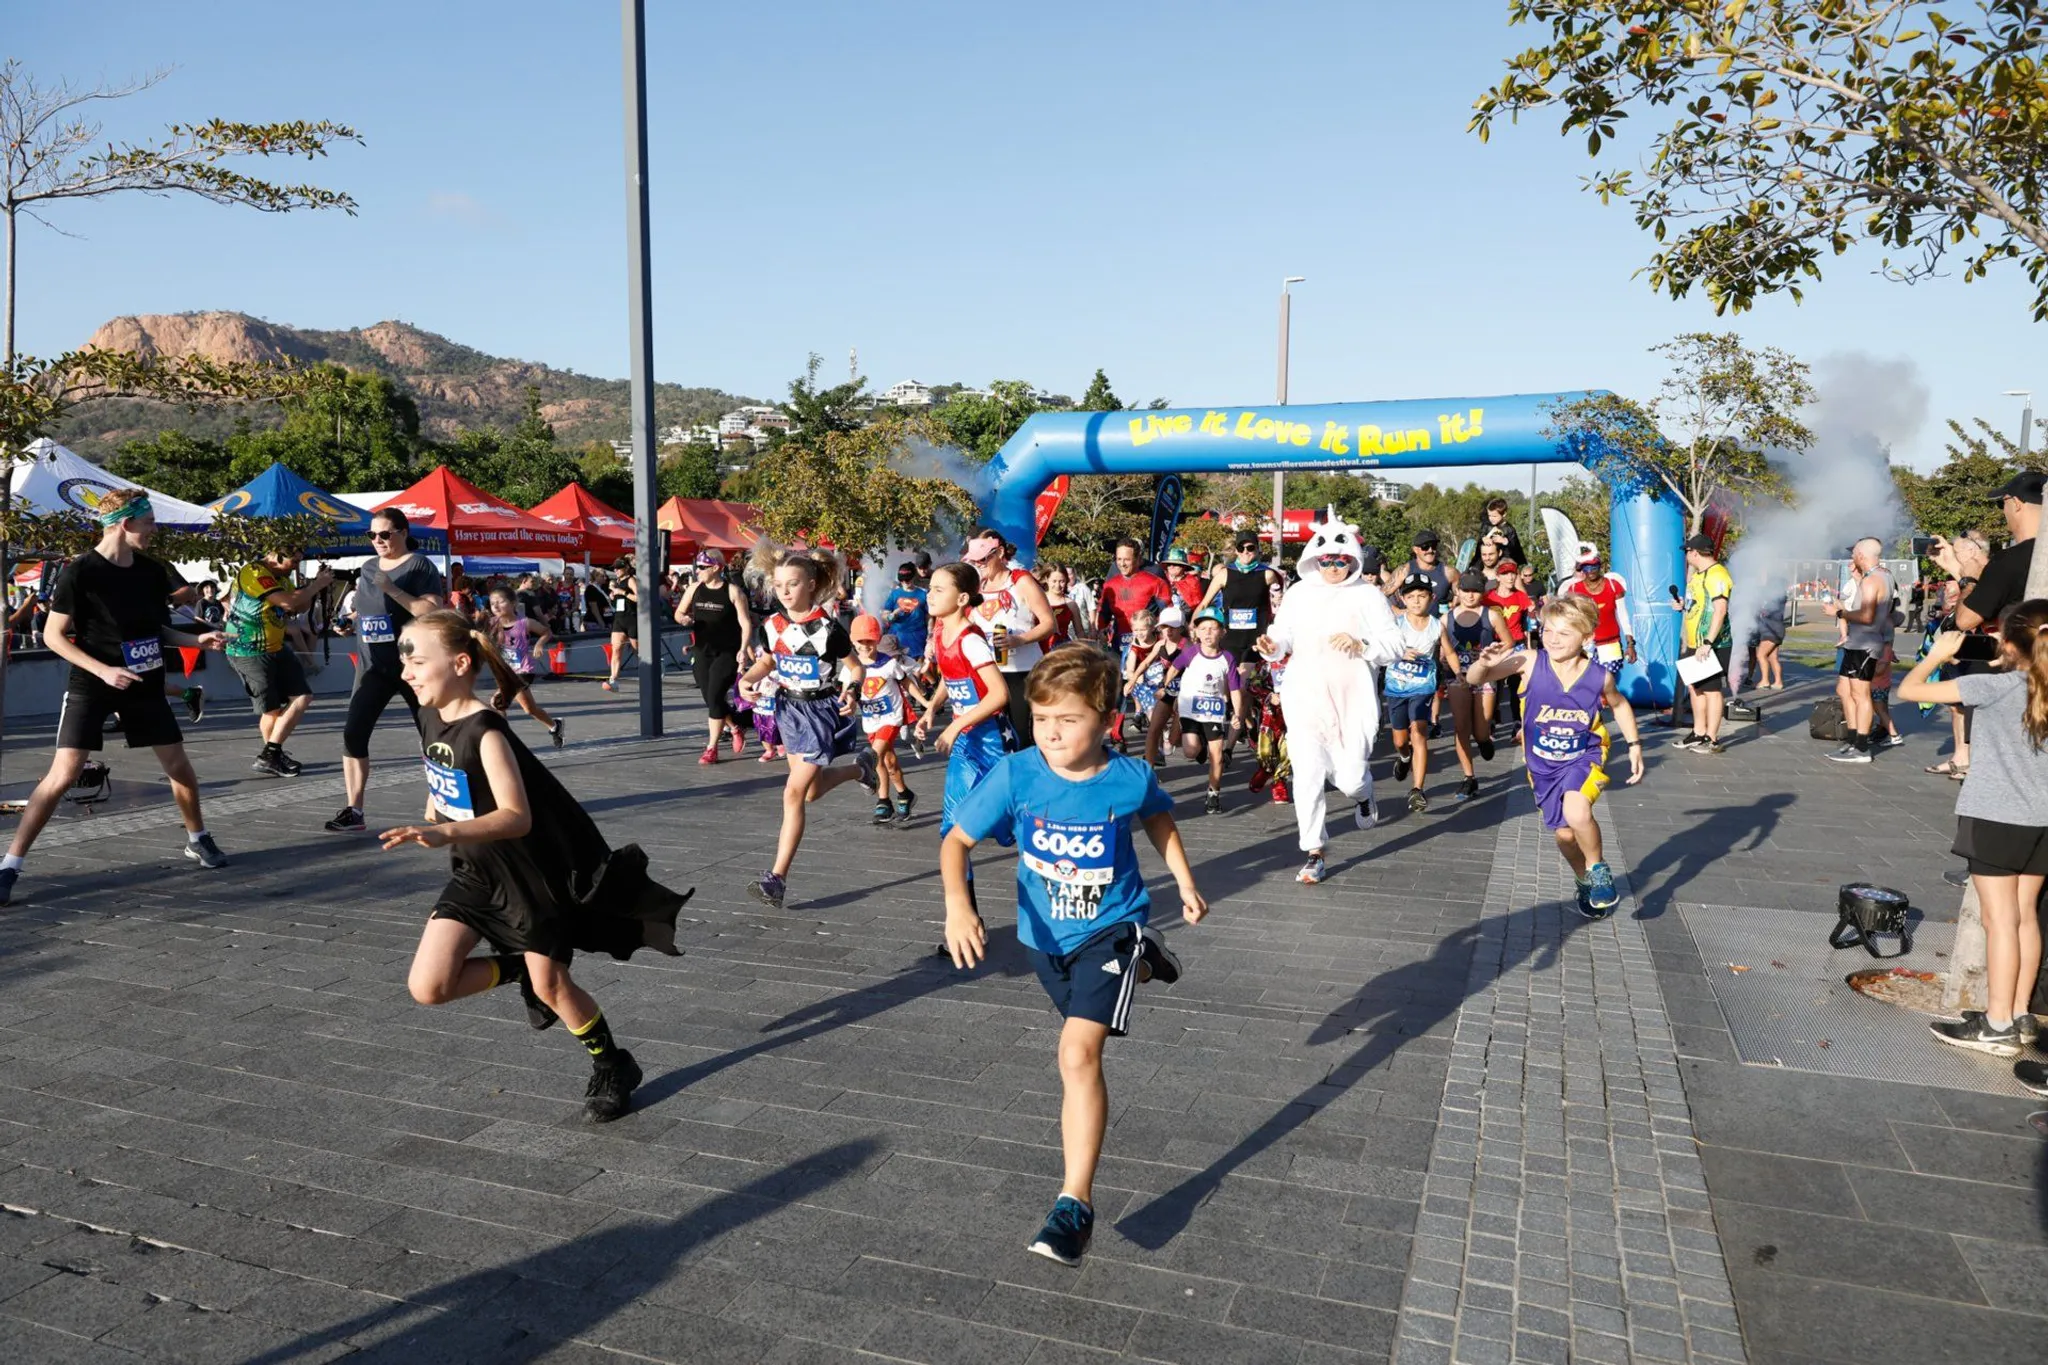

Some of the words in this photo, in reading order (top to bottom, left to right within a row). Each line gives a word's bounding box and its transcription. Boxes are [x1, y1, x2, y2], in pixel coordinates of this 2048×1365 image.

[1129, 414, 1192, 446] Live
[1199, 411, 1228, 437] it
[1234, 412, 1312, 446] Love
[1319, 421, 1350, 455] it
[1358, 424, 1432, 457] Run
[1438, 408, 1484, 444] it!
[1228, 458, 1380, 470] www.townsvillerunningfestival.com
[455, 529, 479, 541] Have
[480, 532, 497, 543] you
[499, 529, 519, 541] read
[520, 529, 534, 541] the
[535, 533, 556, 543] news
[557, 534, 584, 547] today?
[130, 642, 160, 659] 6068
[780, 660, 813, 675] 6060
[1398, 661, 1423, 673] 6021
[949, 685, 972, 701] 065
[863, 701, 888, 714] 6053
[1196, 700, 1222, 712] 6010
[1535, 704, 1591, 726] LAKERS
[1539, 736, 1579, 750] 6061
[1032, 829, 1105, 859] 6066
[1058, 883, 1084, 900] AM
[1089, 885, 1102, 899] A
[1051, 897, 1098, 921] HERO
